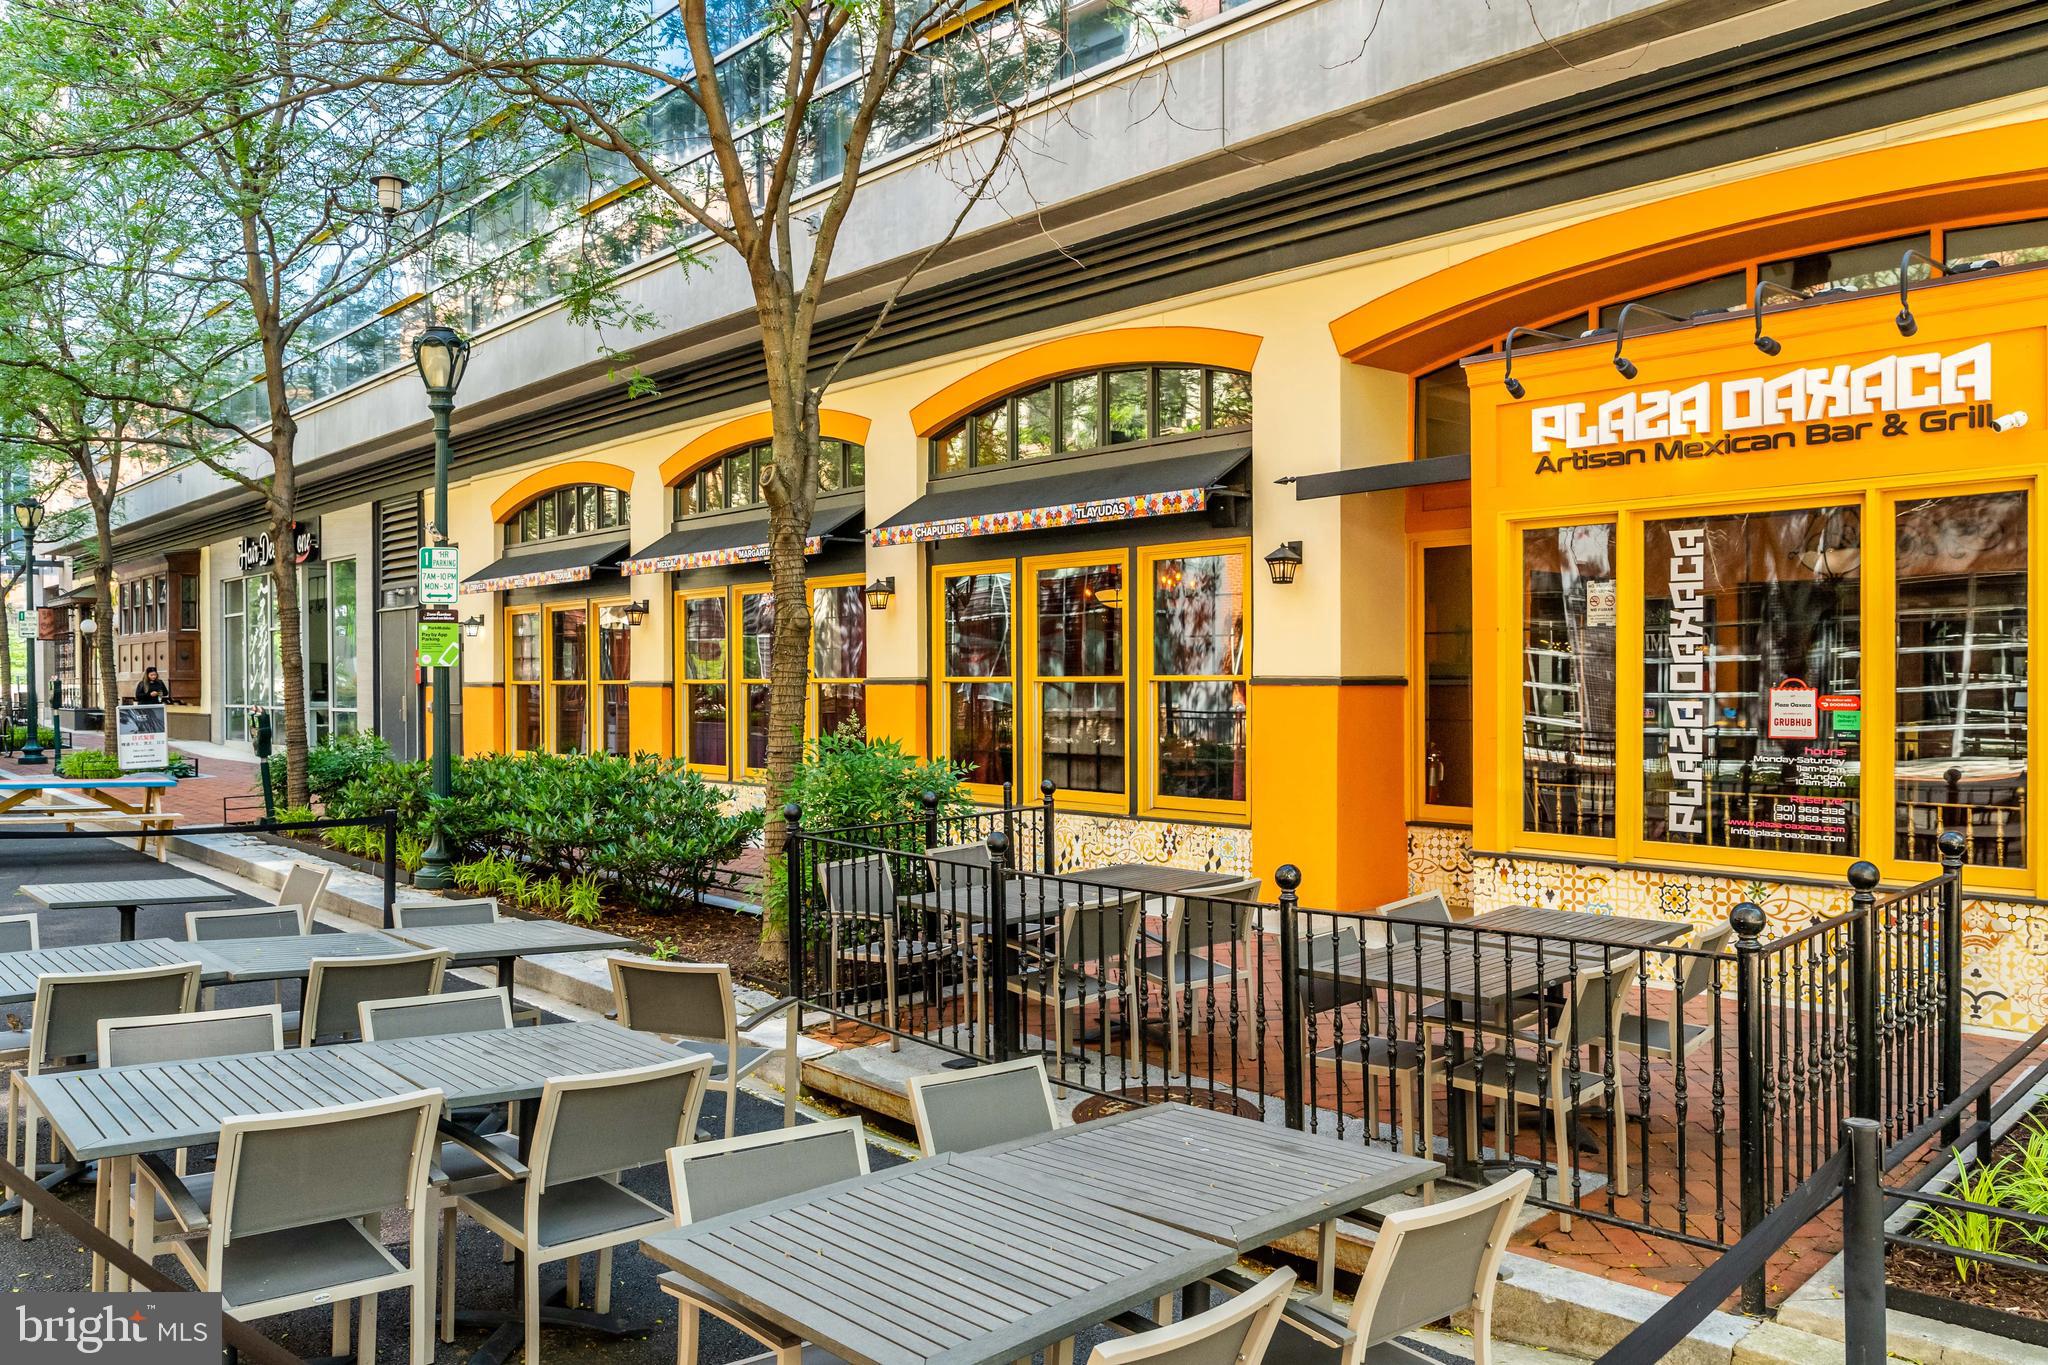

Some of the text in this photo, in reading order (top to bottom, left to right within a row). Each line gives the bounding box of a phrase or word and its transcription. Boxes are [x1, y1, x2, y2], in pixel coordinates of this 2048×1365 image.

[1531, 342, 1992, 453] PLAZA OAXACA
[1535, 403, 1993, 475] Artisan Mexican Bar & Grill
[915, 502, 1126, 538] CHAPULINES TLAYUDAS
[238, 538, 259, 571] Hair
[424, 551, 430, 567] 1
[433, 559, 457, 567] PARKING
[656, 560, 678, 569] MEZCAL
[1668, 528, 1704, 691] OAXACA
[1774, 717, 1812, 727] GRUBHUB
[1804, 746, 1847, 756] hours:
[1753, 755, 1845, 766] Monday-Saturday
[1668, 699, 1703, 835] PLAZA
[1795, 778, 1846, 787] 10am-9pm
[1802, 773, 1843, 782] Sunday
[1773, 804, 1845, 816] (301) 968-2136
[1773, 813, 1845, 825] (301) 968-2135
[1728, 819, 1846, 834] www.plaza-oaxaca.com
